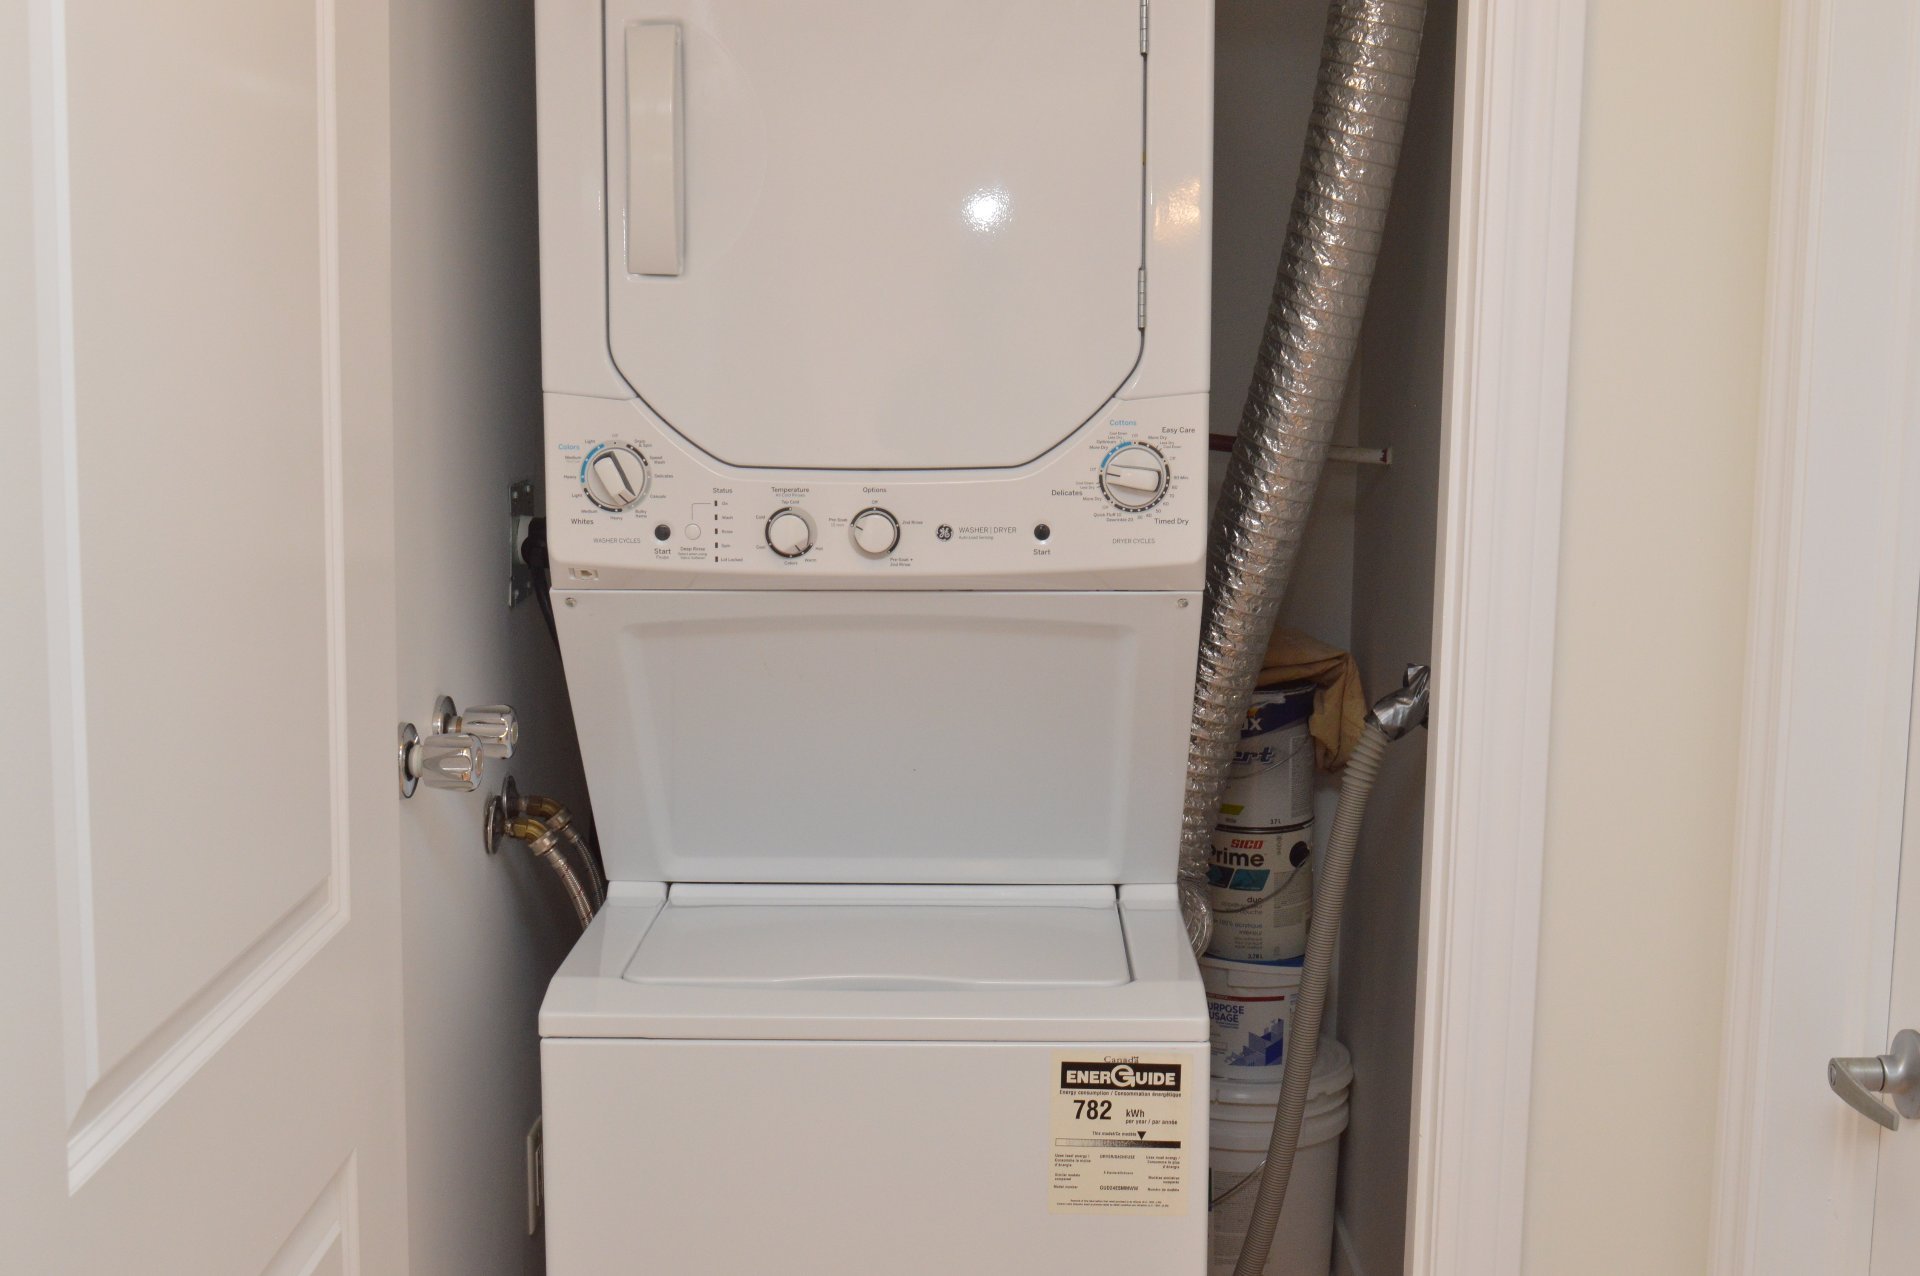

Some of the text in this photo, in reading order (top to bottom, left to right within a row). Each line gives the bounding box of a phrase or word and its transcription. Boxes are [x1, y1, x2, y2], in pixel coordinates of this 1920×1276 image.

[1177, 518, 1190, 526] Dry
[1231, 839, 1264, 850] SICO
[1066, 1064, 1176, 1088] ENERGUIDE
[1073, 1099, 1112, 1120] 782
[1125, 1109, 1145, 1118] kWh
